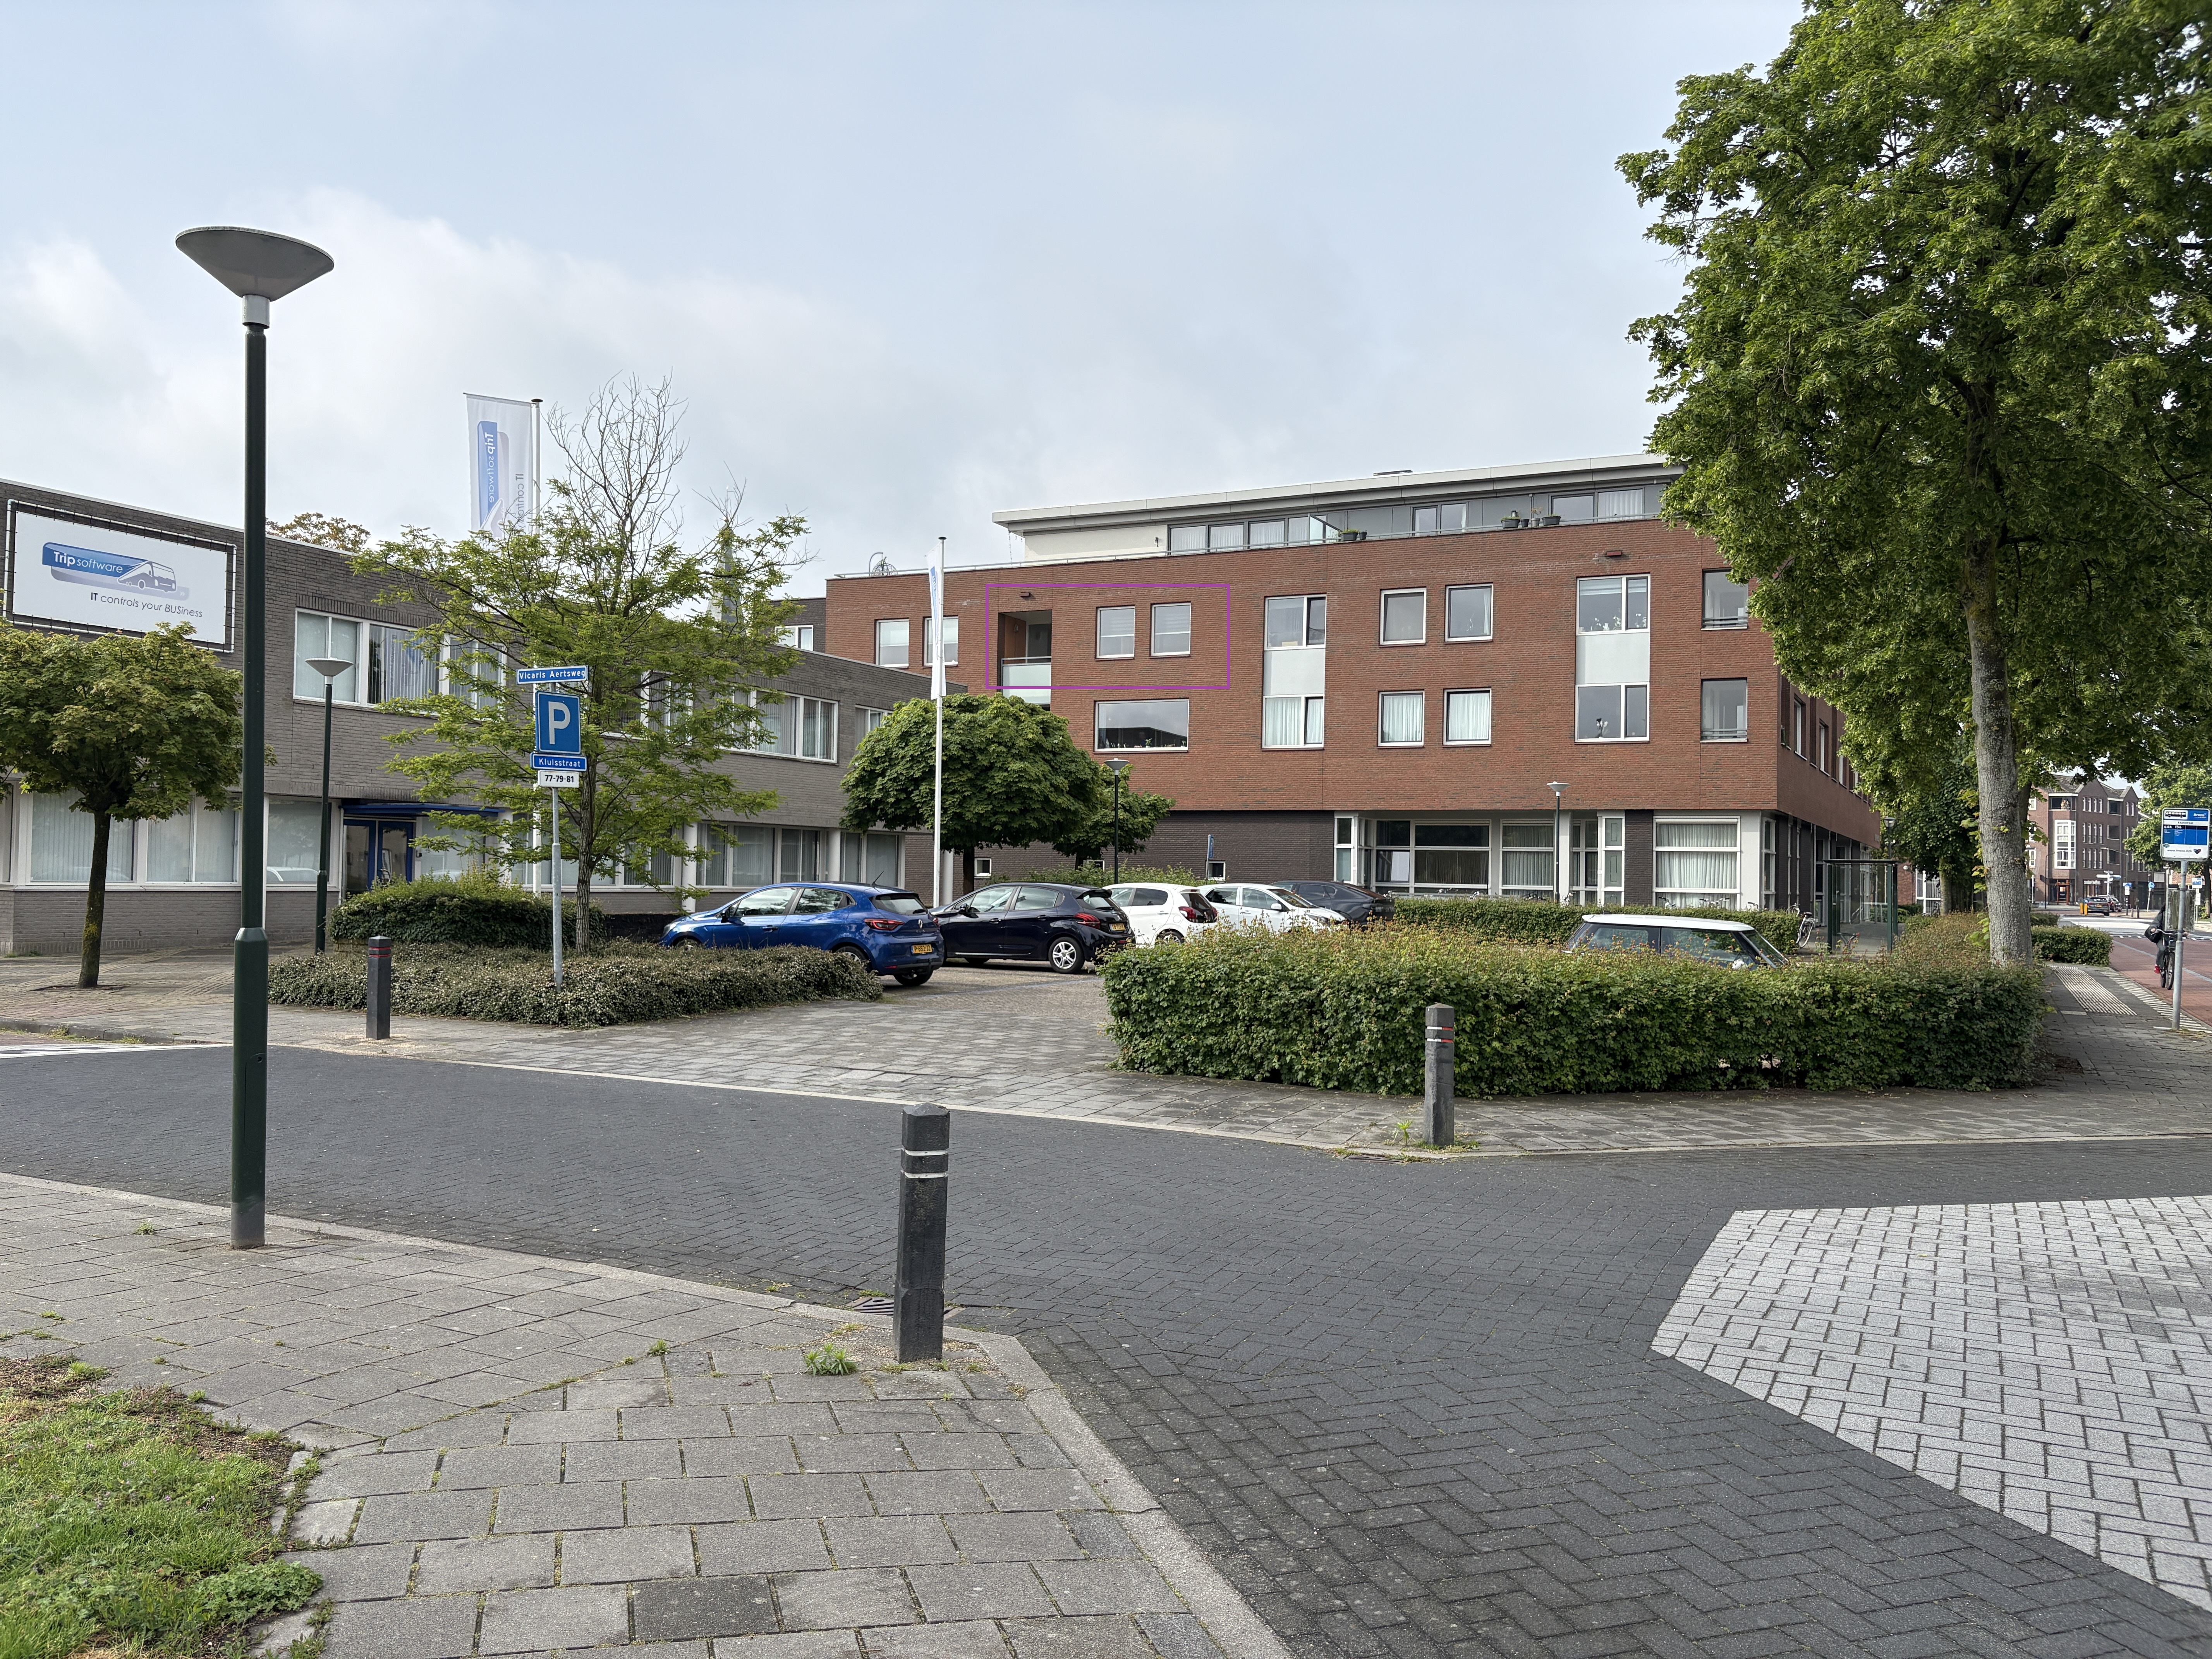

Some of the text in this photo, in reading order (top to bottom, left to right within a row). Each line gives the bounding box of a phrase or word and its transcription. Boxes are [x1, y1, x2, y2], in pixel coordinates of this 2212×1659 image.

[53, 551, 123, 573] Trip software
[91, 592, 203, 617] IT controls your BUSiness
[519, 671, 546, 679] Vicaris
[548, 701, 570, 744] P
[539, 758, 580, 767] Kluisstraat
